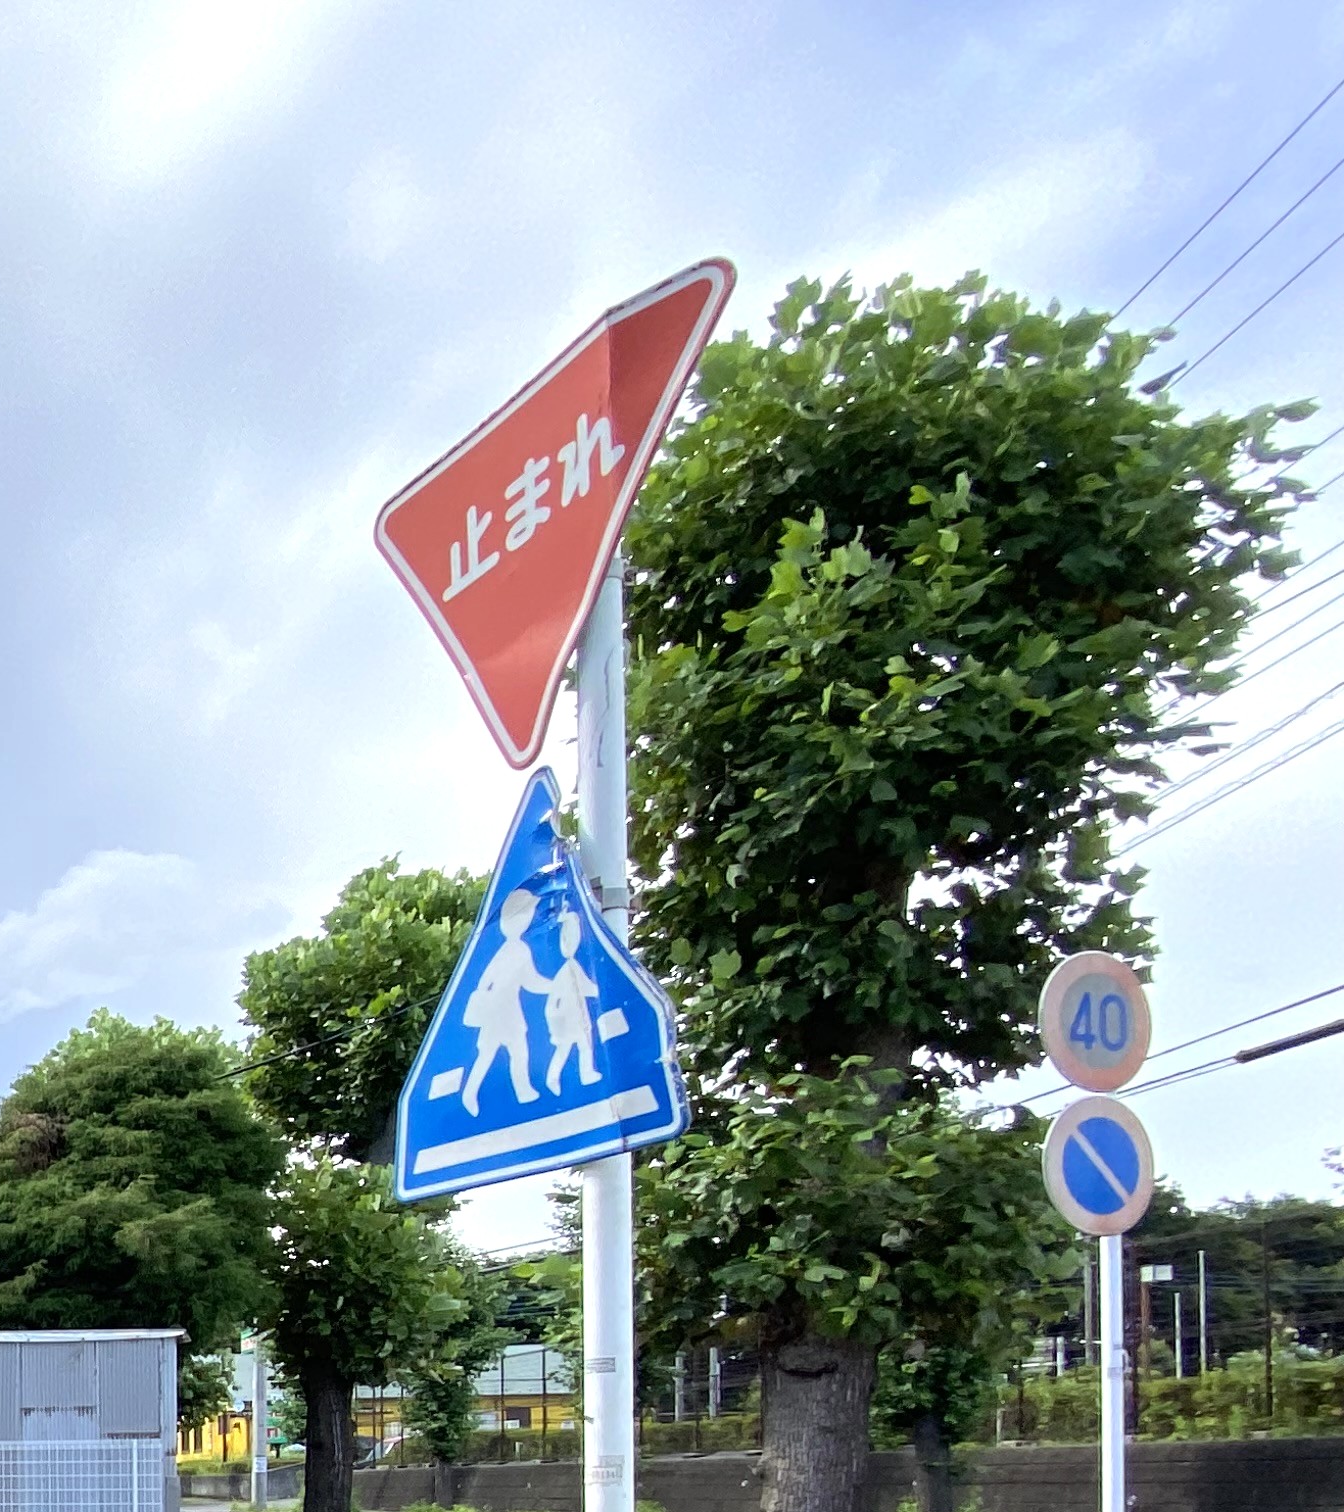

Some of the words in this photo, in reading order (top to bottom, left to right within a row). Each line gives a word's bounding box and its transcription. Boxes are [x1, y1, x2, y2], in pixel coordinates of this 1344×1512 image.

[441, 412, 626, 602] 止まれ
[1069, 991, 1128, 1052] 40
